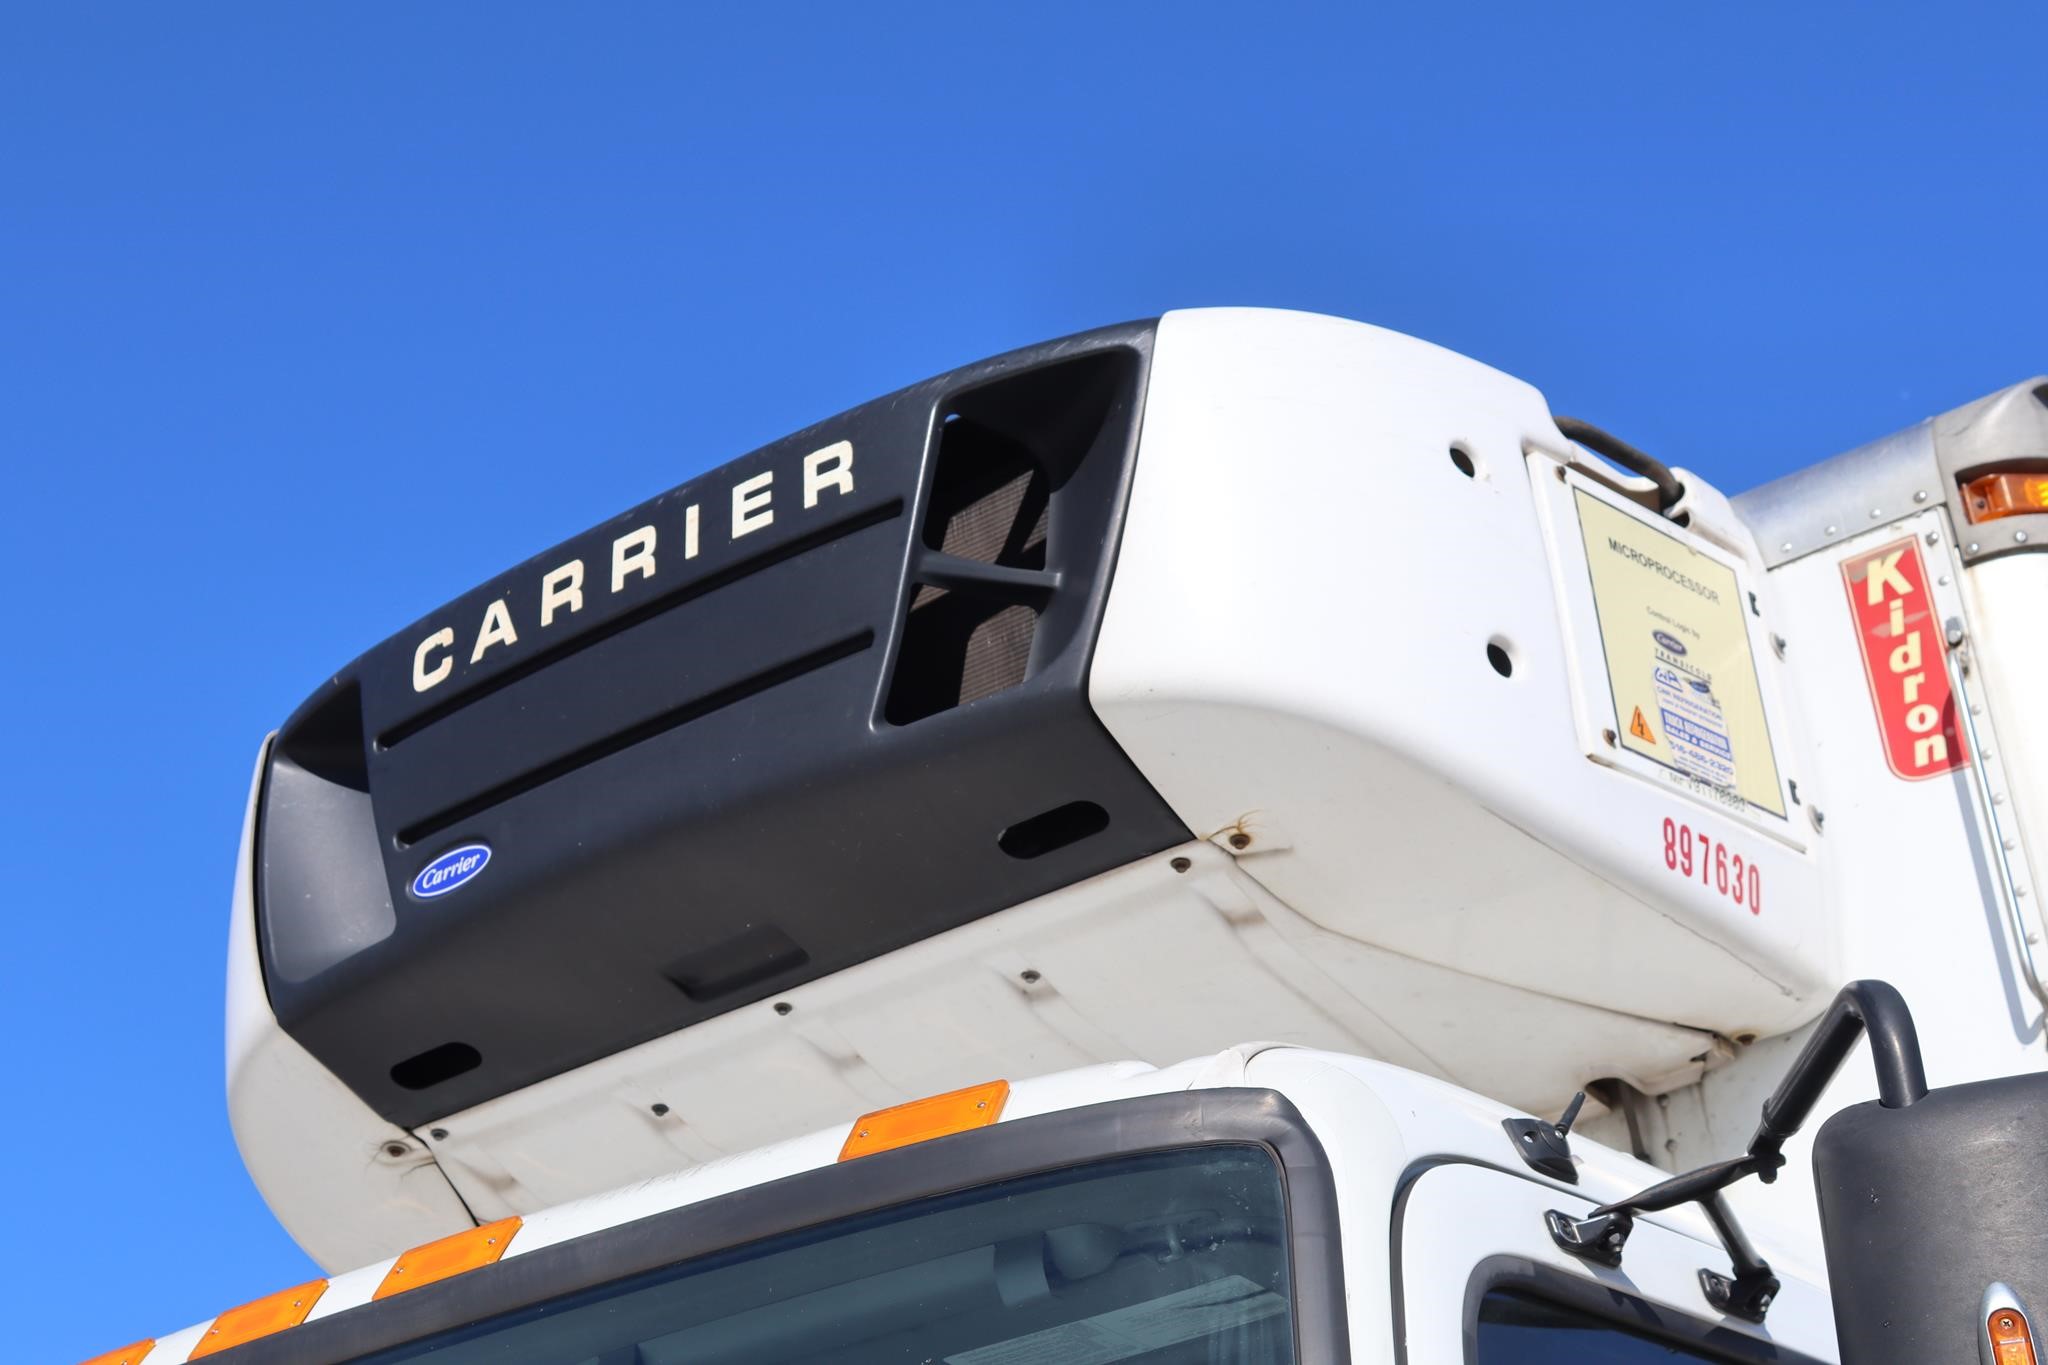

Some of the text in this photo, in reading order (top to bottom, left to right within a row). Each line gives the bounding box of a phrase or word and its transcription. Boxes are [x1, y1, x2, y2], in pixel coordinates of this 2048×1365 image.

[412, 440, 855, 693] CARRIER
[1607, 537, 1720, 605] MICROPROCESSOR
[1867, 549, 1948, 768] Kidron
[421, 849, 481, 890] Carrier
[1663, 816, 1760, 916] 897630
